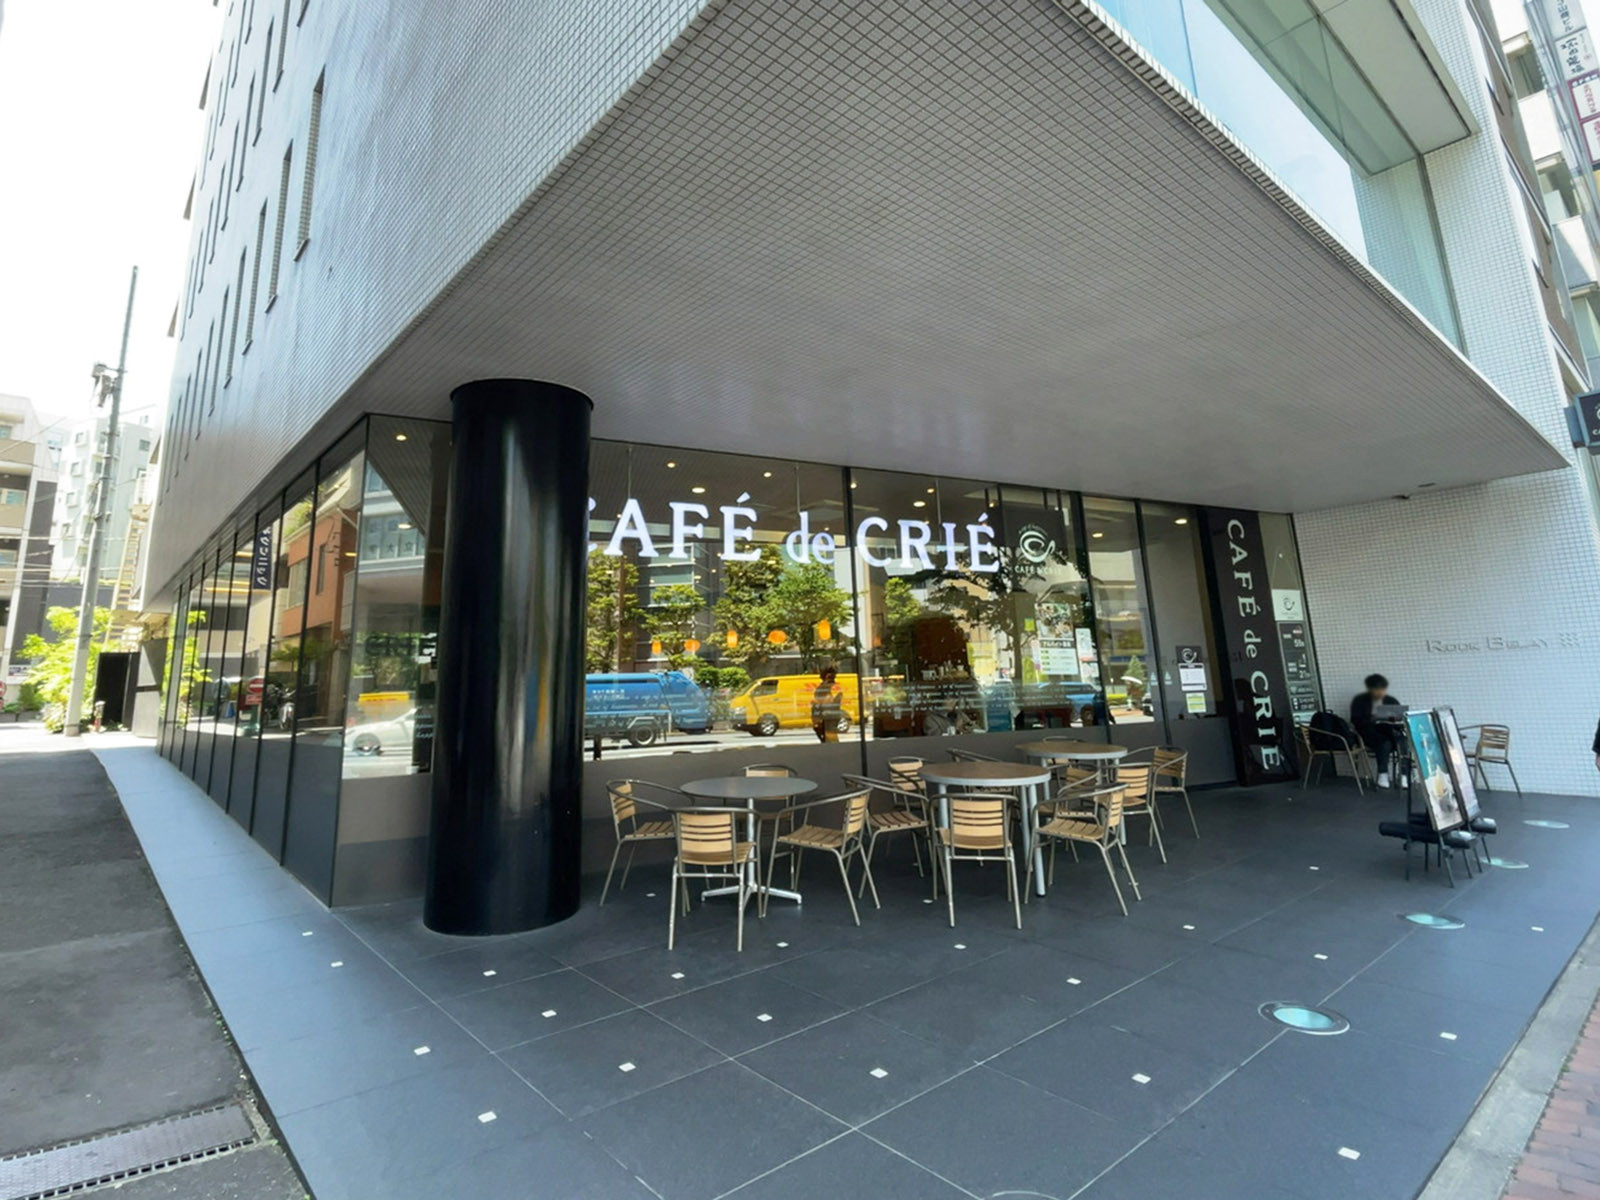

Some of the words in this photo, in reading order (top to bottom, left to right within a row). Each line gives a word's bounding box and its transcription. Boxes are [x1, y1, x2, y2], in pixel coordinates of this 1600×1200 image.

[589, 492, 762, 562] AFÉ
[786, 511, 835, 565] de
[856, 512, 1000, 573] CRIÉ
[1227, 519, 1261, 618] CAFÉ
[1243, 629, 1262, 658] de
[1250, 670, 1285, 770] CRIÉ
